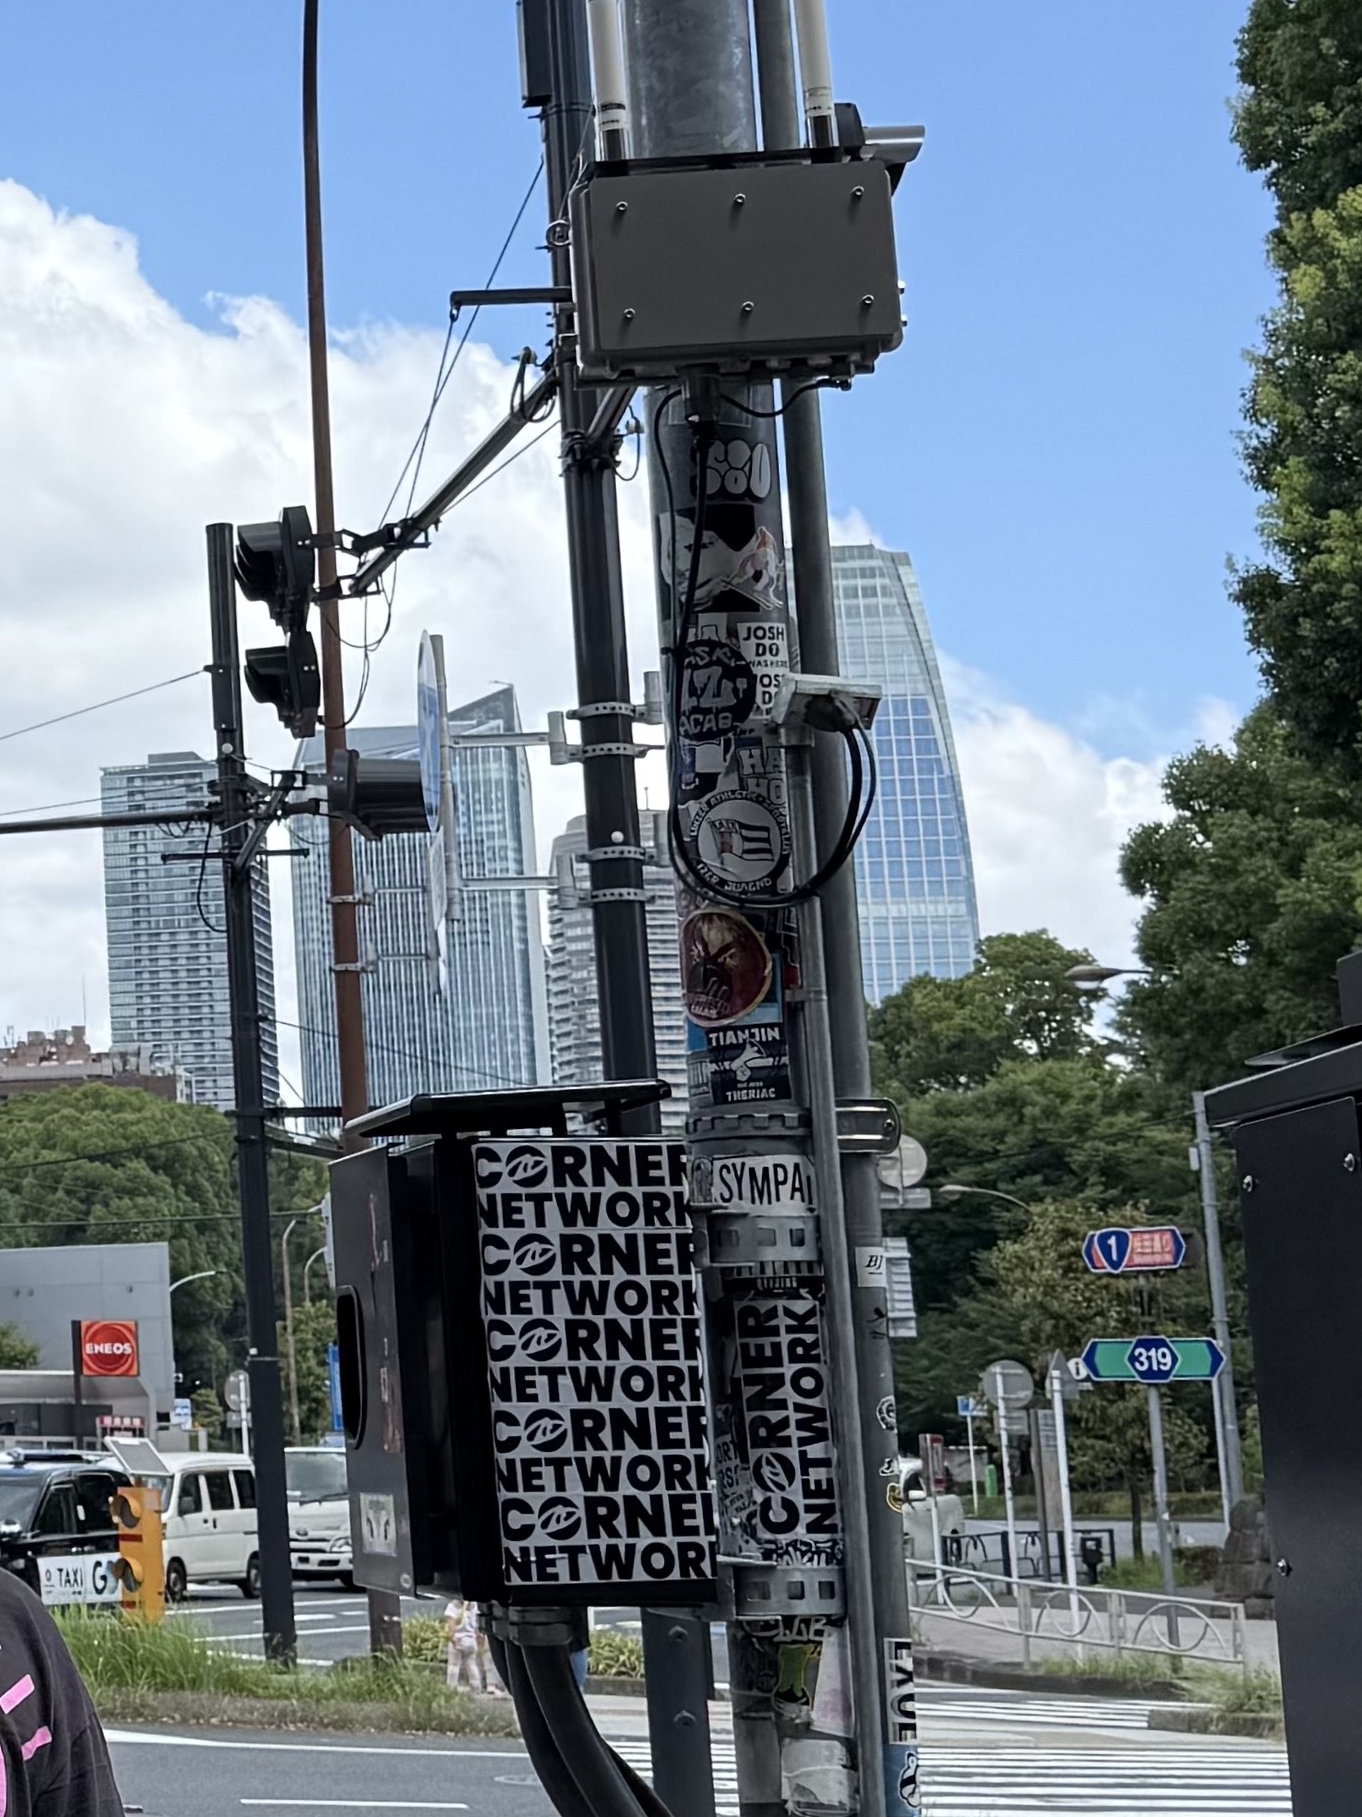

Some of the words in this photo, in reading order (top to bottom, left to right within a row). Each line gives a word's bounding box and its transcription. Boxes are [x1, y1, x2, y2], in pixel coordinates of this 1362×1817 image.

[742, 625, 785, 642] JOSH
[678, 712, 733, 736] ACAB
[708, 1026, 780, 1047] TIANJIN
[1107, 1235, 1118, 1262] 1
[85, 1342, 132, 1354] ENEOS
[1134, 1347, 1172, 1372] 319
[737, 1304, 800, 1535] CORNER
[782, 1304, 839, 1534] NETWORK
[57, 1567, 84, 1588] TAXI
